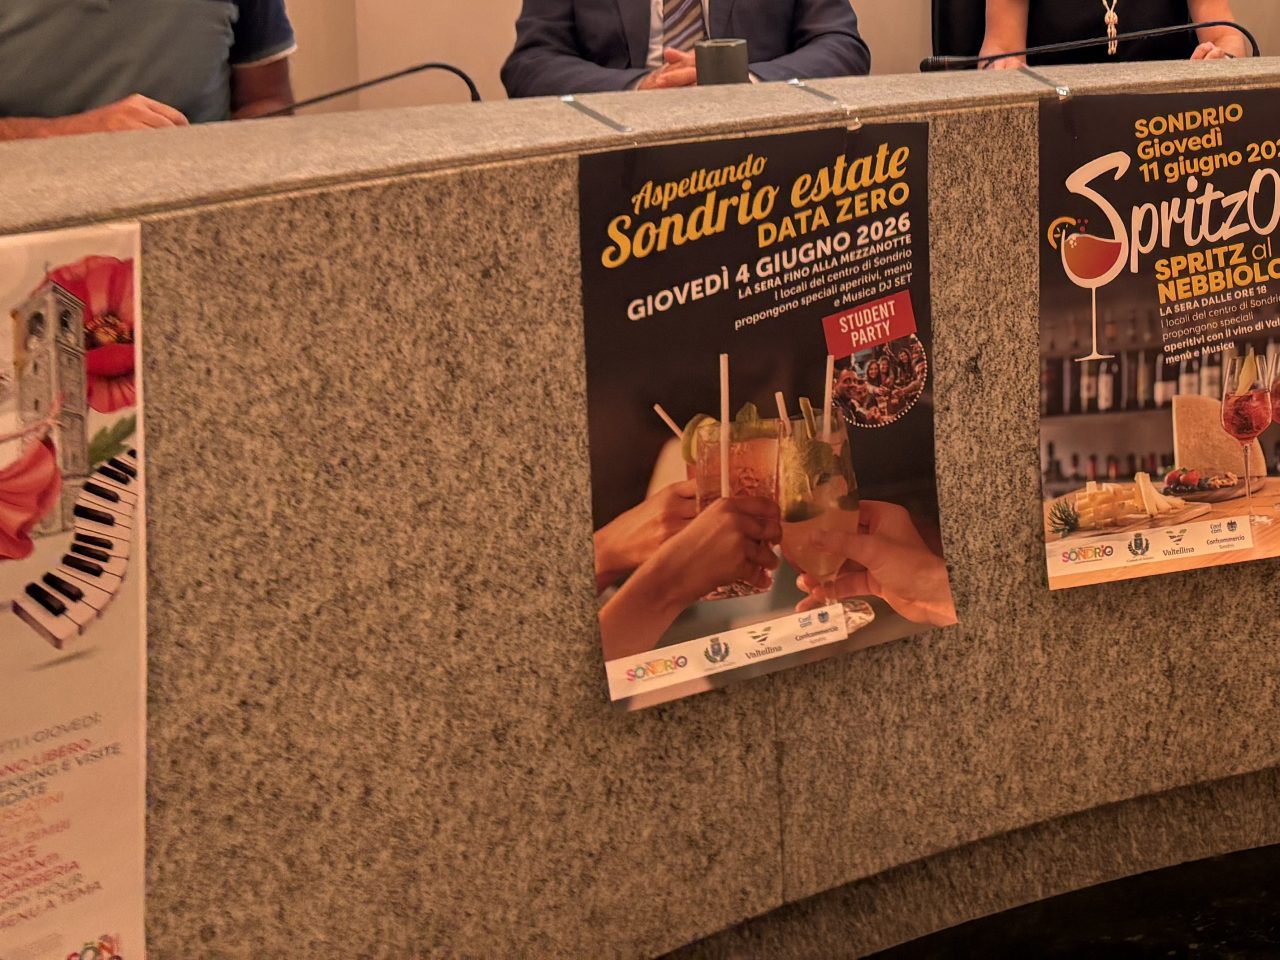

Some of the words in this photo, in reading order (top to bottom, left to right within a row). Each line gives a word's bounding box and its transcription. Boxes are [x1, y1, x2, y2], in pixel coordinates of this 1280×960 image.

[1135, 104, 1243, 139] SONDRIO
[1137, 127, 1222, 160] Giovedì
[1139, 162, 1160, 182] 11
[1165, 149, 1242, 183] giugno
[632, 152, 767, 215] Aspettando
[601, 180, 779, 268] Sondrio
[791, 143, 909, 208] estate
[758, 208, 829, 248] DATA
[837, 182, 910, 222] ZERO
[626, 265, 729, 321] GIOVEDÌ
[735, 264, 750, 283] 4
[755, 230, 850, 278] GIUGNO
[857, 212, 911, 246] 2026
[738, 286, 753, 300] LA
[754, 277, 782, 293] SERA
[784, 267, 810, 283] FINO
[812, 257, 838, 274] ALLA
[840, 234, 911, 264] MEZZANOTTE
[781, 280, 807, 299] locali
[810, 276, 825, 289] del
[828, 266, 859, 282] centro
[862, 262, 871, 272] di
[873, 250, 912, 268] Sondrio
[1154, 242, 1246, 281] SPRITZ
[1252, 237, 1272, 260] al
[735, 300, 799, 330] propongono
[801, 286, 837, 307] speciali
[840, 272, 882, 292] aperitivi,
[884, 262, 912, 277] menù
[842, 286, 876, 304] Musica
[879, 281, 892, 292] DJ
[895, 273, 912, 287] SET
[1160, 306, 1172, 316] LA
[1174, 301, 1199, 313] SERA
[1201, 292, 1232, 307] DALLE
[1234, 288, 1254, 300] ORE
[1257, 285, 1267, 294] 18
[839, 300, 896, 333] STUDENT
[1163, 321, 1218, 342] propongono
[1220, 313, 1253, 327] speciali
[1165, 314, 1190, 327] locali
[1192, 311, 1207, 322] del
[1209, 305, 1237, 318] centro
[1240, 301, 1248, 310] di
[851, 321, 890, 347] PARTY
[1164, 334, 1204, 353] aperitivi
[1207, 329, 1224, 341] con
[1233, 326, 1253, 336] vino
[1255, 321, 1264, 331] di
[1165, 350, 1192, 364] menù
[1202, 341, 1235, 355] Musica
[1162, 546, 1194, 557] Valtellina
[745, 644, 782, 661] Valtellina
